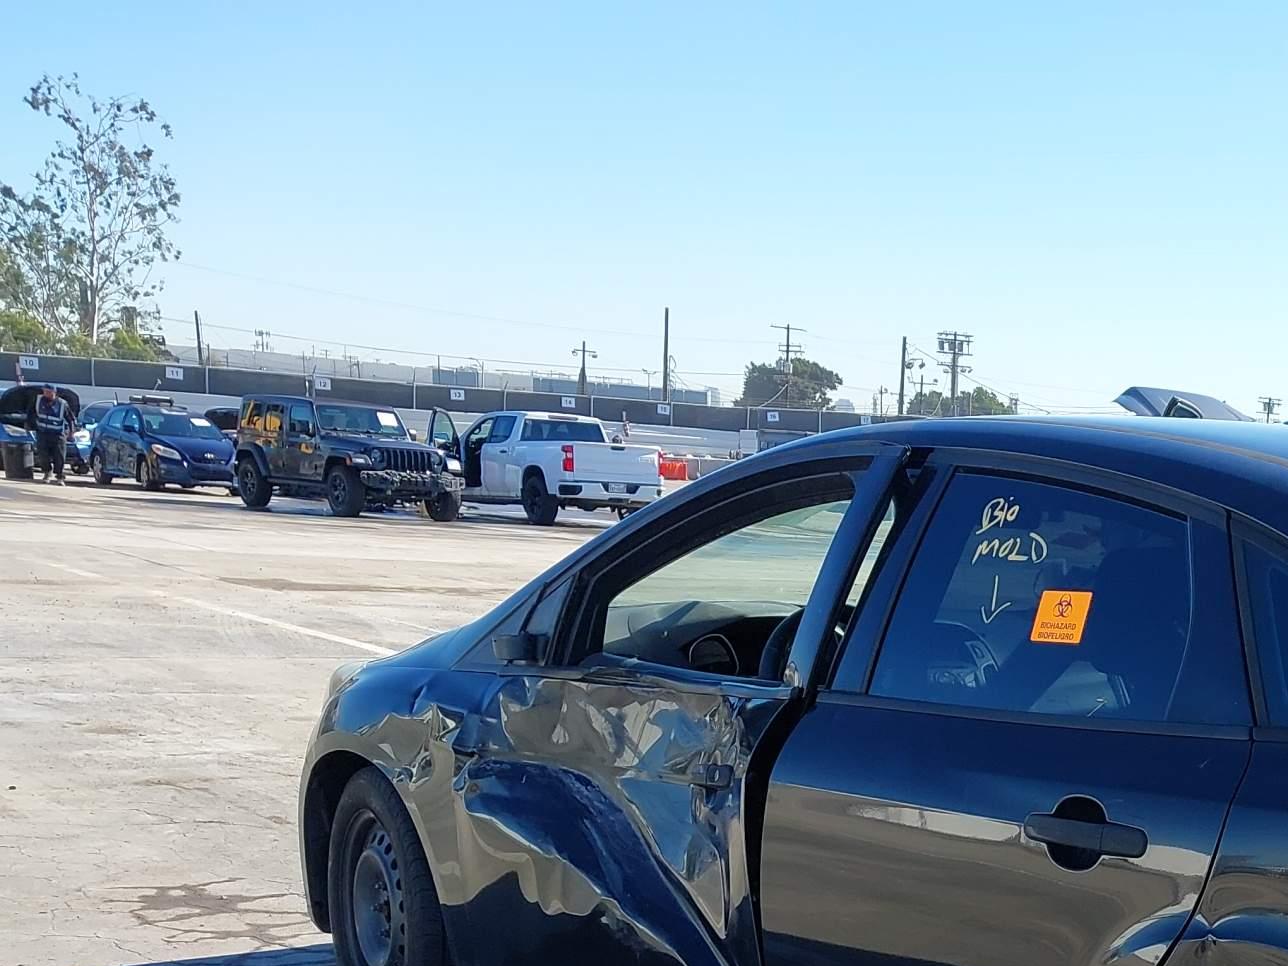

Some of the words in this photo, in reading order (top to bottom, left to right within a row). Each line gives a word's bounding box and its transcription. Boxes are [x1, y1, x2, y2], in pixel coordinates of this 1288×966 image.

[24, 359, 34, 367] 10
[319, 380, 328, 388] 12
[1040, 621, 1077, 631] BIOHAZARD
